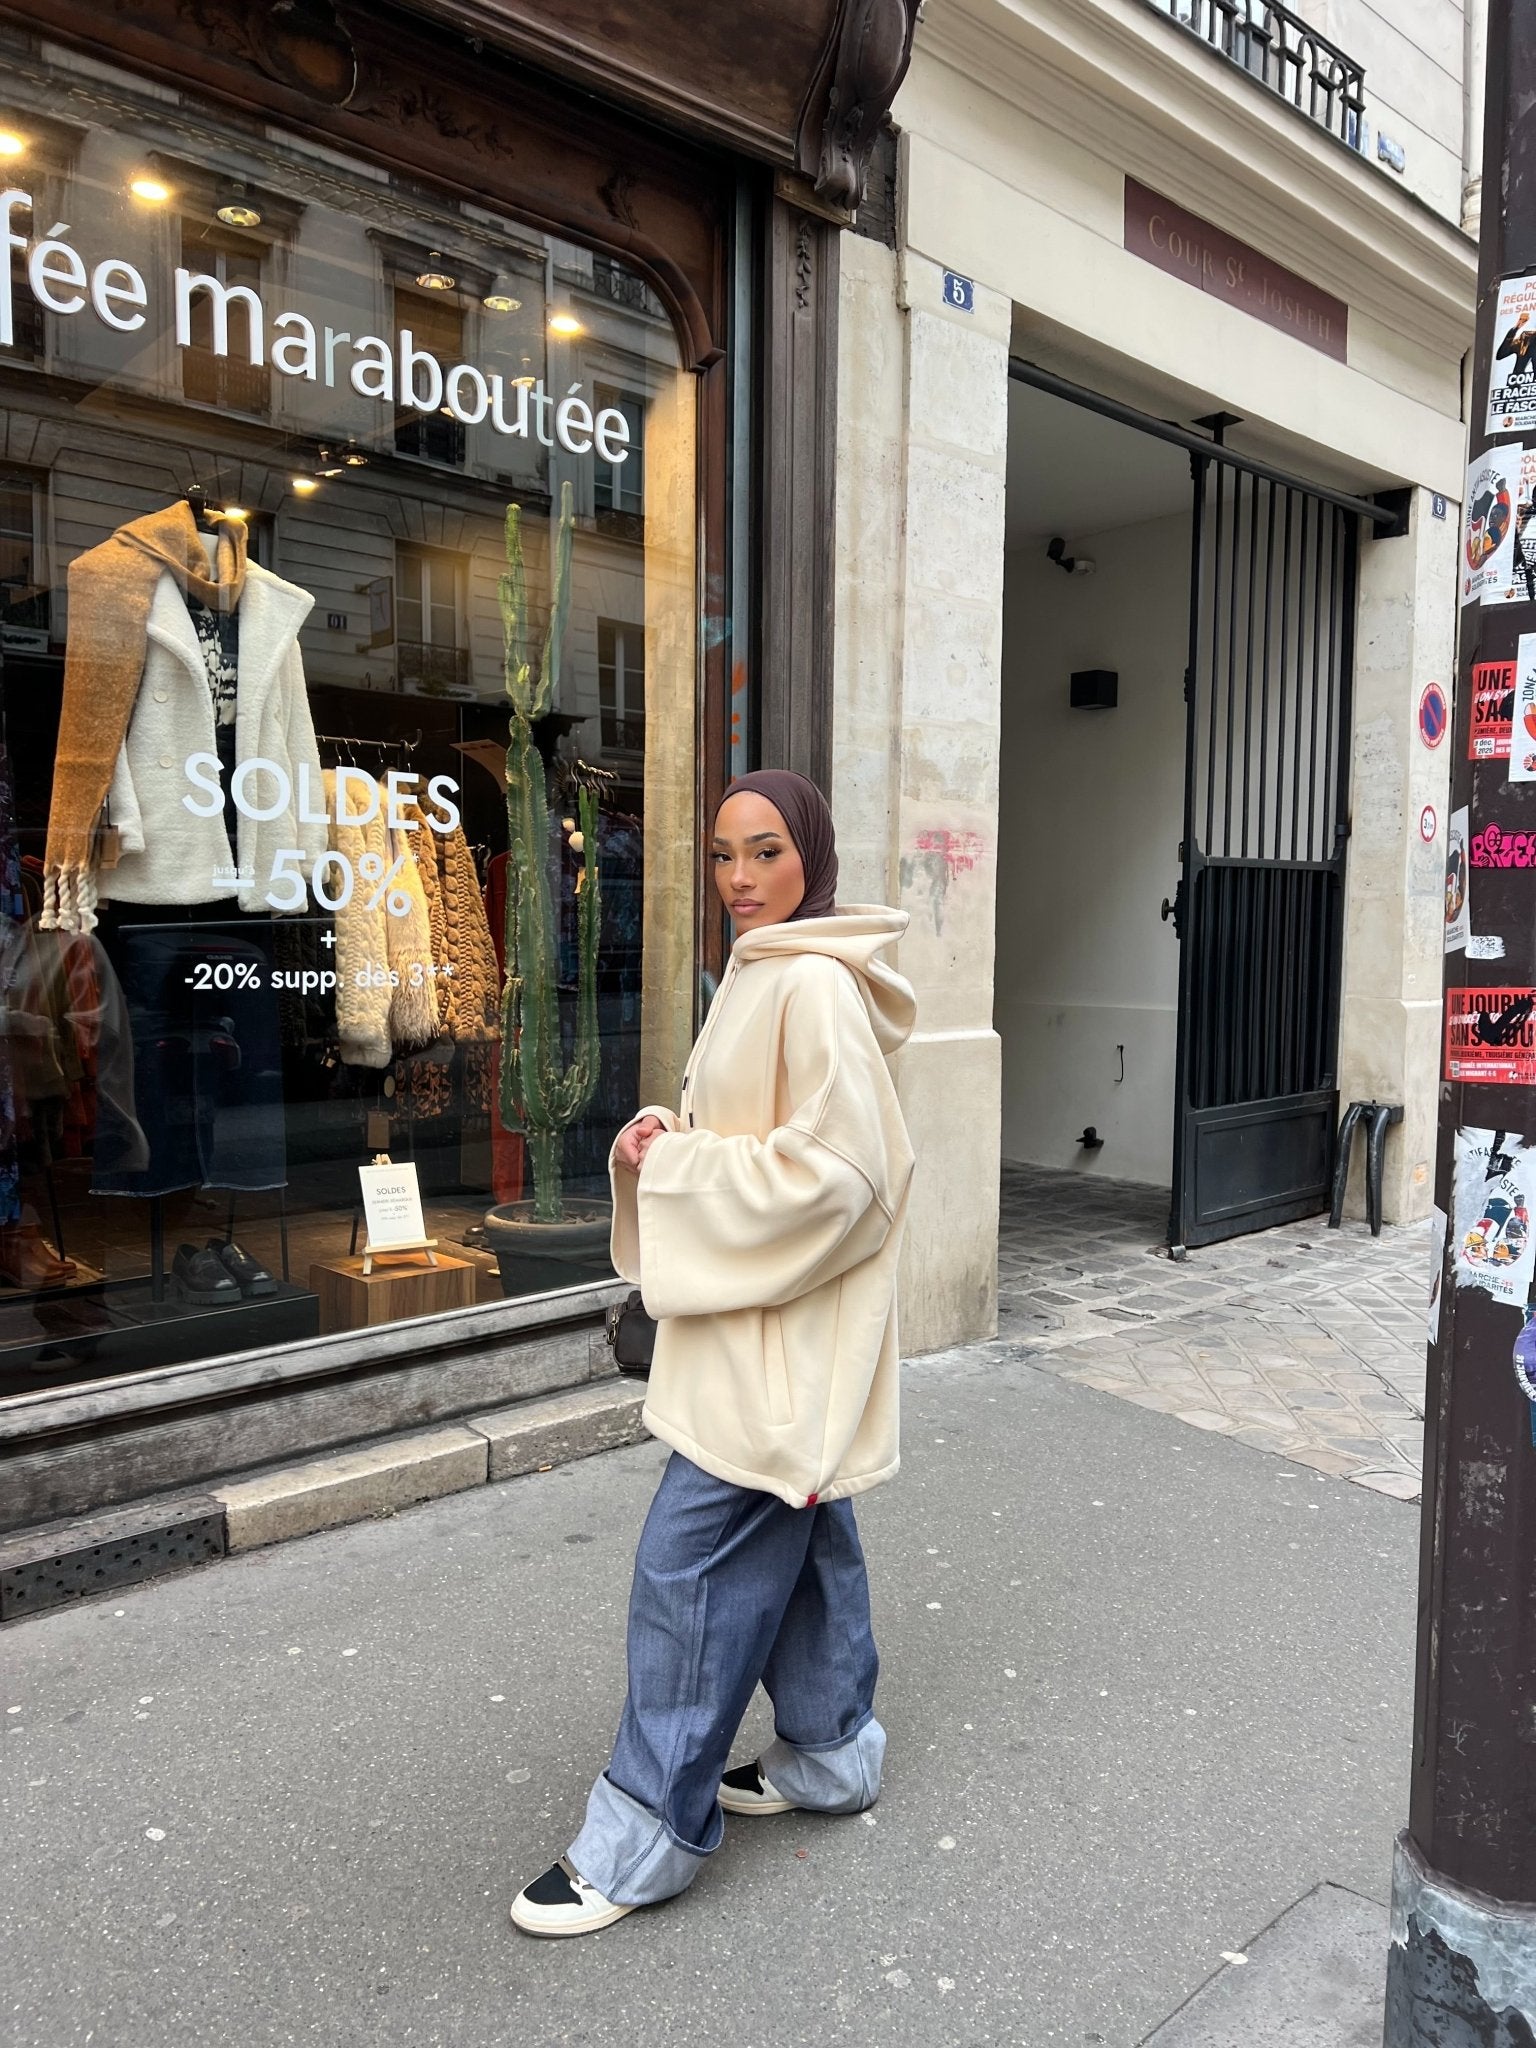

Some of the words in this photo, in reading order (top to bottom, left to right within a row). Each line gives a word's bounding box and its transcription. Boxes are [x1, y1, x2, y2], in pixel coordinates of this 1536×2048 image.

[953, 278, 965, 304] 5
[1149, 215, 1215, 278] COUR
[1258, 277, 1331, 341] JOSEPH
[175, 265, 631, 464] maraboutée
[1491, 404, 1504, 414] LE
[1478, 667, 1512, 691] UNE
[181, 752, 461, 834] SOLDES
[184, 963, 261, 990] -20%
[271, 970, 345, 995] supp.
[355, 961, 400, 988] dès
[377, 1186, 406, 1195] SOLDES
